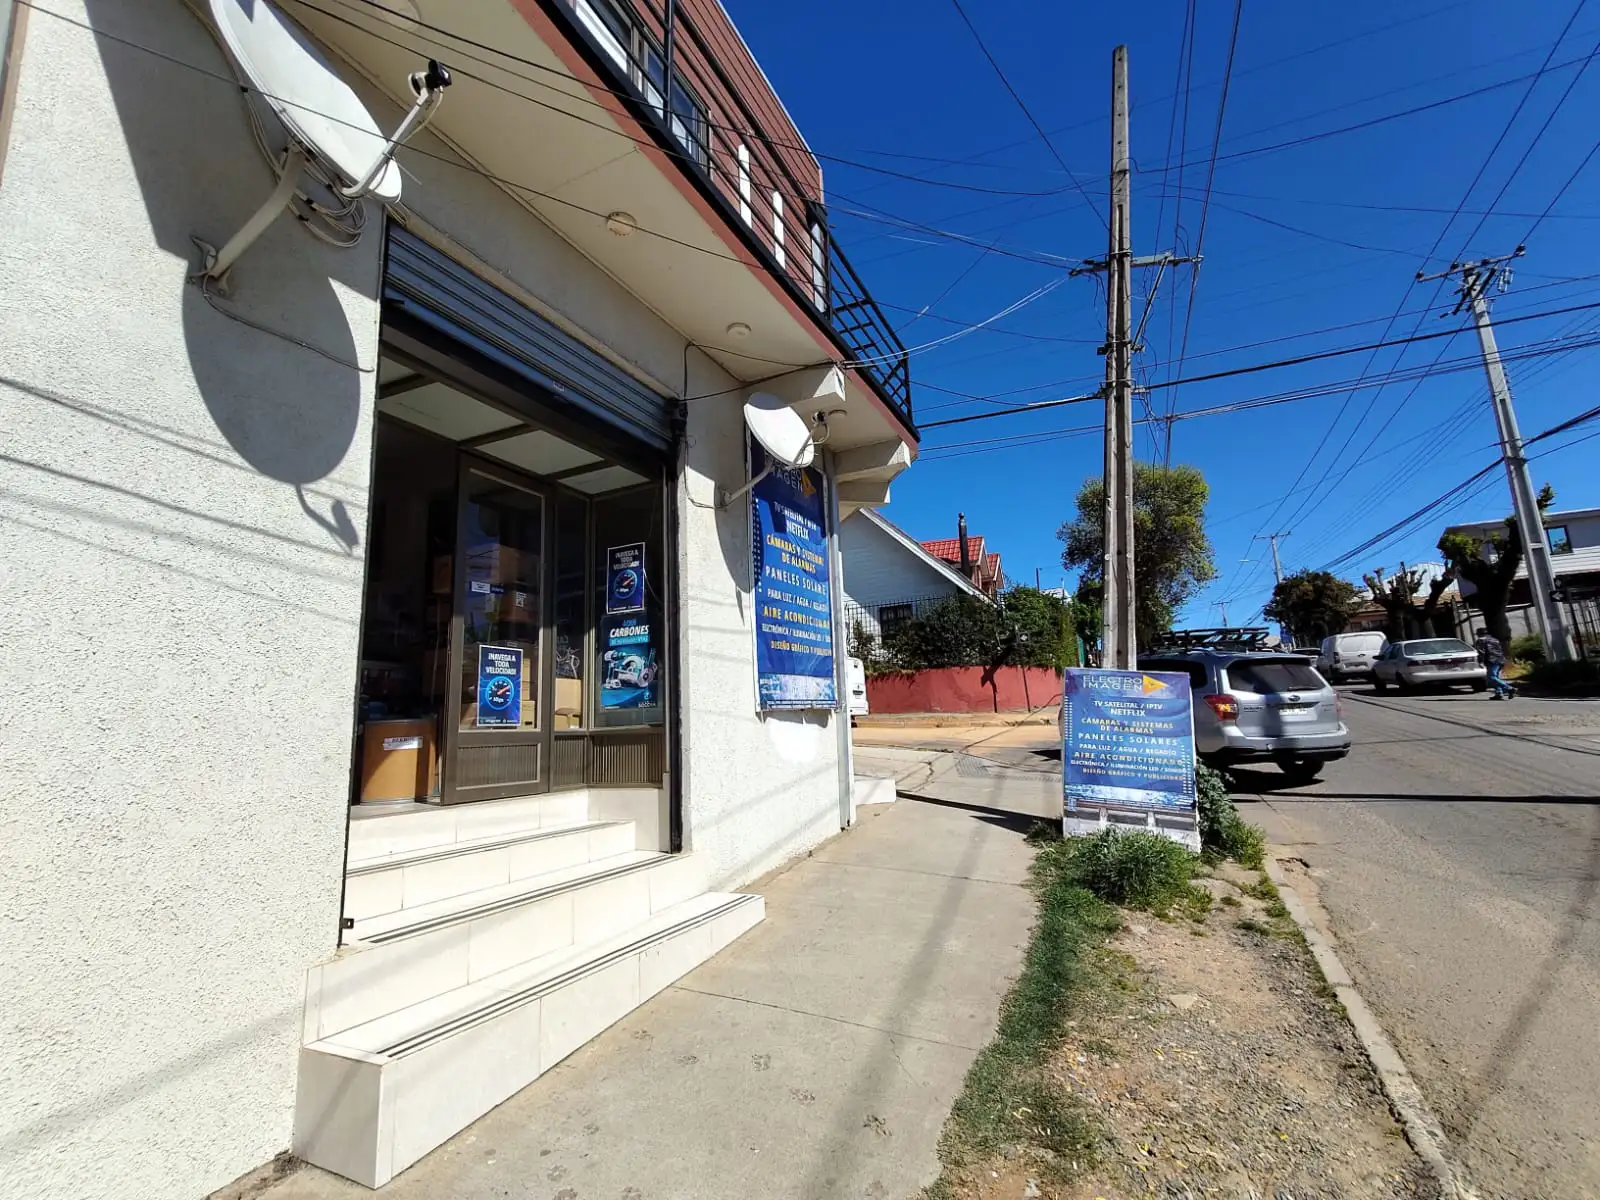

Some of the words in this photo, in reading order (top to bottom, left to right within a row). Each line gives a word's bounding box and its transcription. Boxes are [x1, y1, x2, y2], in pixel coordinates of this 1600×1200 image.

[786, 519, 810, 541] NETFLIX
[796, 545, 800, 556] Y
[782, 552, 790, 564] DE
[792, 556, 816, 574] ALARMAS
[766, 565, 800, 586] PANELES
[768, 588, 782, 600] PARA
[782, 592, 792, 602] LUZ
[796, 596, 808, 608] AGUA
[764, 606, 782, 620] AIRE
[610, 624, 650, 638] CARBONES
[1083, 675, 1142, 685] ELECTRO
[1083, 682, 1142, 692] IMAGEN
[1104, 701, 1138, 709] SATELITAL
[1110, 708, 1146, 717] NETFLIX
[1114, 726, 1154, 734] ALARMAS
[1078, 733, 1124, 742] PANELES
[1130, 736, 1178, 746] SOLARES
